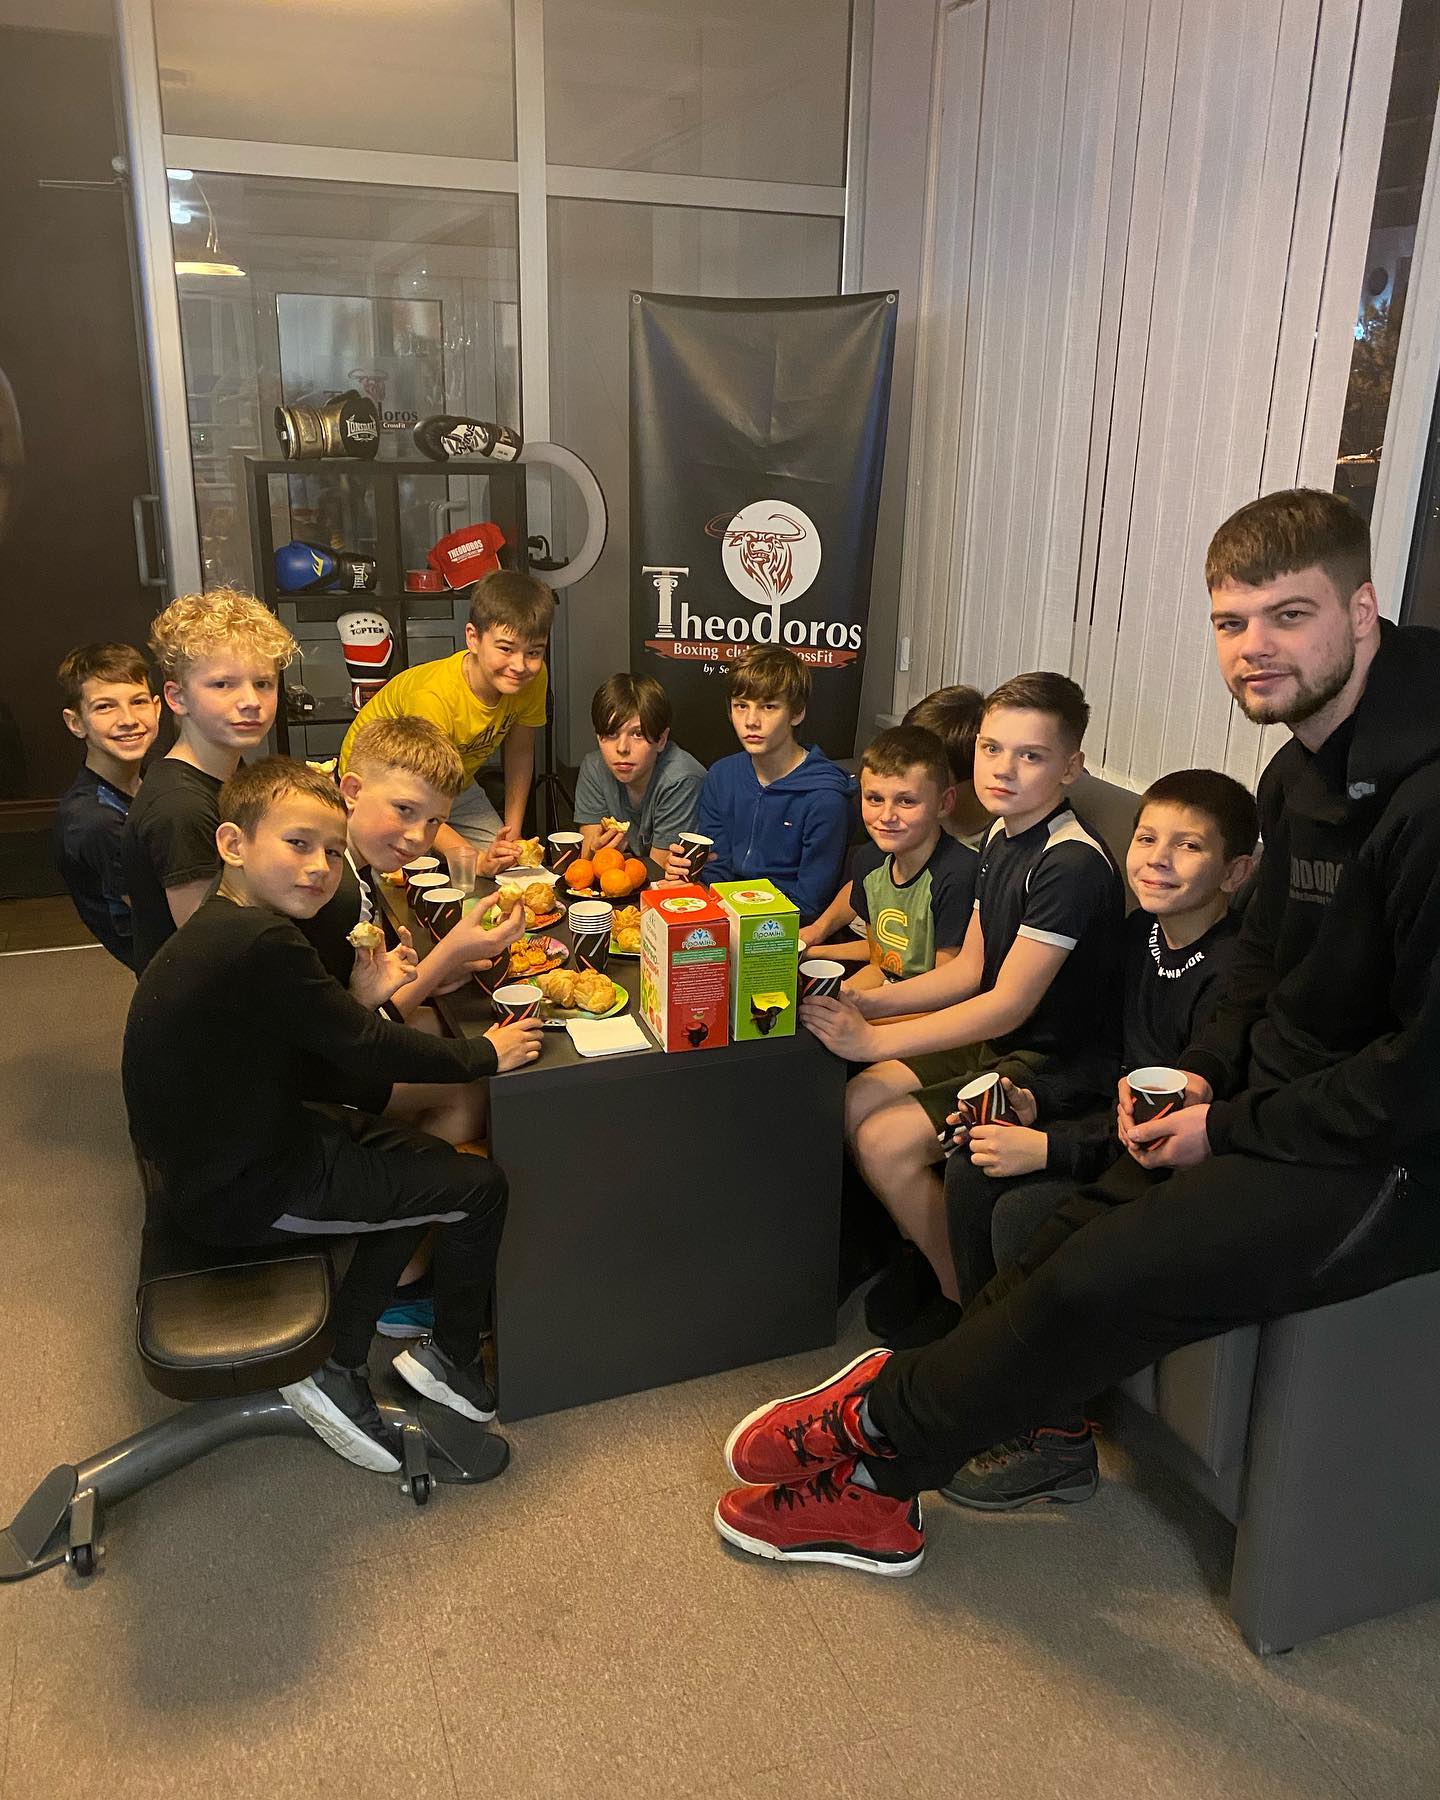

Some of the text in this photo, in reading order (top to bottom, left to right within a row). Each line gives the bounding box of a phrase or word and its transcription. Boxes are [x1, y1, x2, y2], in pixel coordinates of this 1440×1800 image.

[447, 539, 483, 559] THEODOROS
[352, 564, 366, 588] EVERLAST
[641, 565, 862, 650] Theodoros
[673, 642, 719, 661] Boxing
[703, 663, 730, 676] by Se
